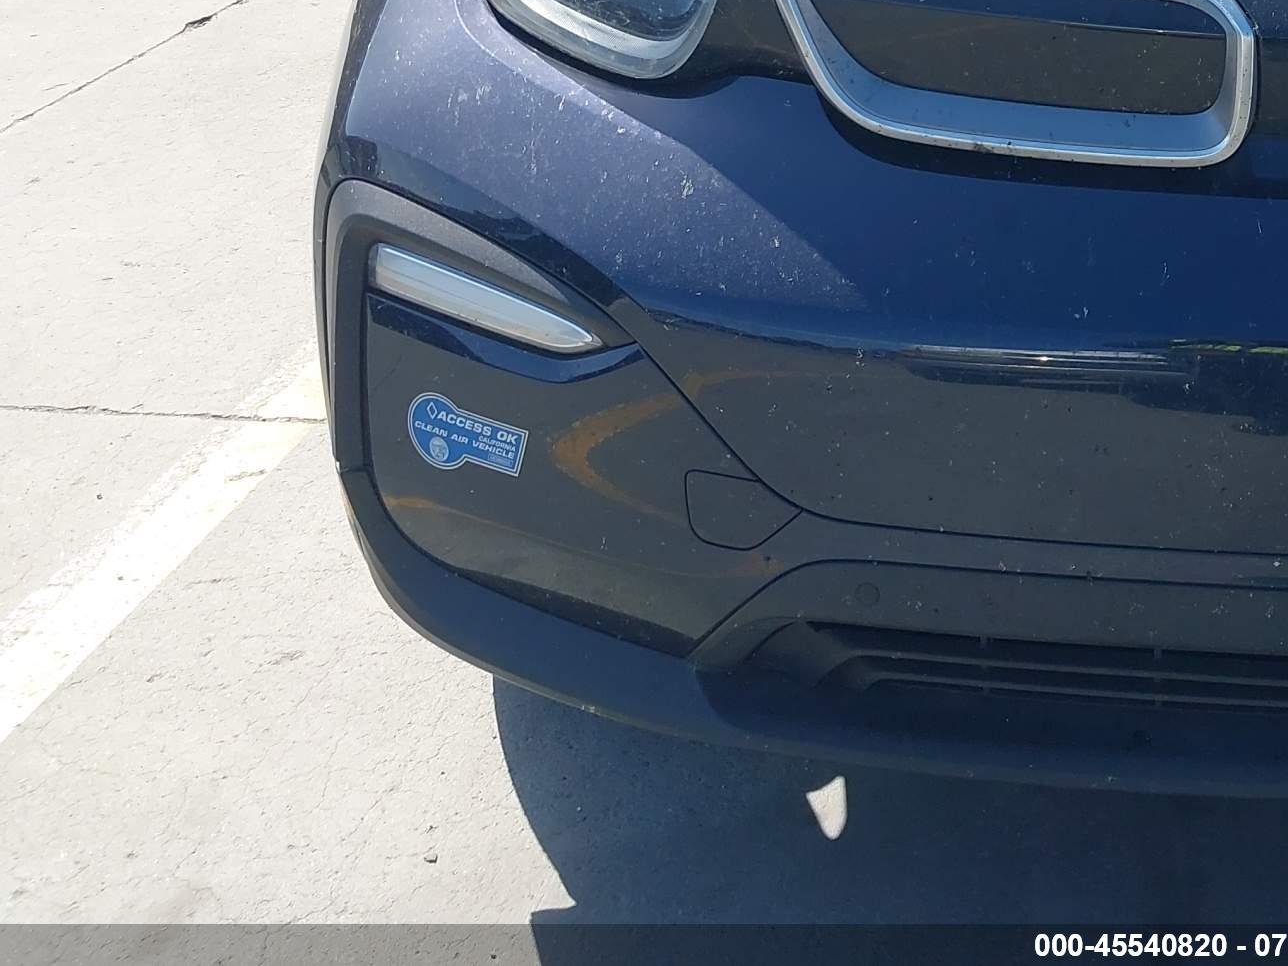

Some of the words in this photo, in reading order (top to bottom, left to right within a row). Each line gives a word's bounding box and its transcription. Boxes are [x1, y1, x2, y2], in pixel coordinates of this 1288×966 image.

[414, 420, 448, 438] CLEAN
[450, 433, 469, 445] AIR
[472, 439, 515, 459] VEHICLE
[437, 410, 492, 437] ACCESS
[496, 430, 519, 445] OK
[478, 435, 516, 452] CALIFORNIA
